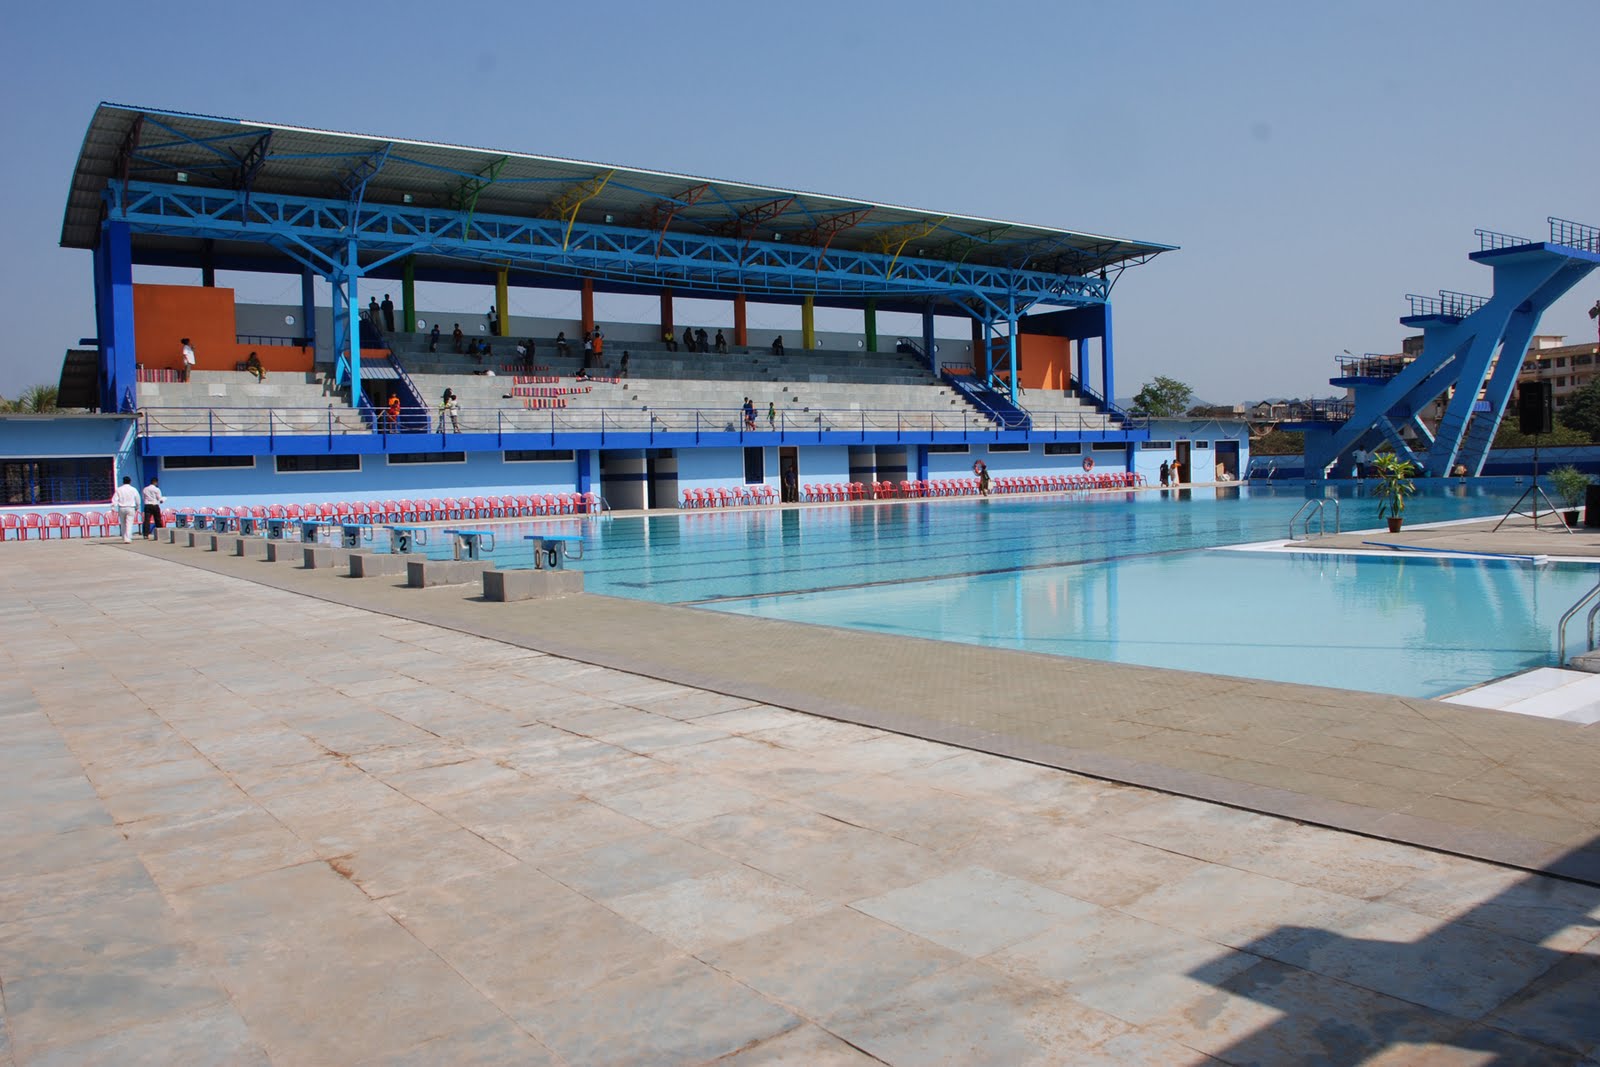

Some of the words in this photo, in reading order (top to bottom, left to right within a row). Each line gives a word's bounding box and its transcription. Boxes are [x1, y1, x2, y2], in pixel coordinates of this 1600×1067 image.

[180, 518, 186, 527] 9
[199, 520, 205, 529] 8
[220, 521, 226, 532] 7
[245, 523, 251, 534] 6
[273, 526, 279, 538] 5
[308, 529, 314, 542] 4
[349, 533, 356, 546] 3
[399, 536, 407, 551] 2
[467, 541, 473, 558] 1
[548, 549, 557, 568] 0
